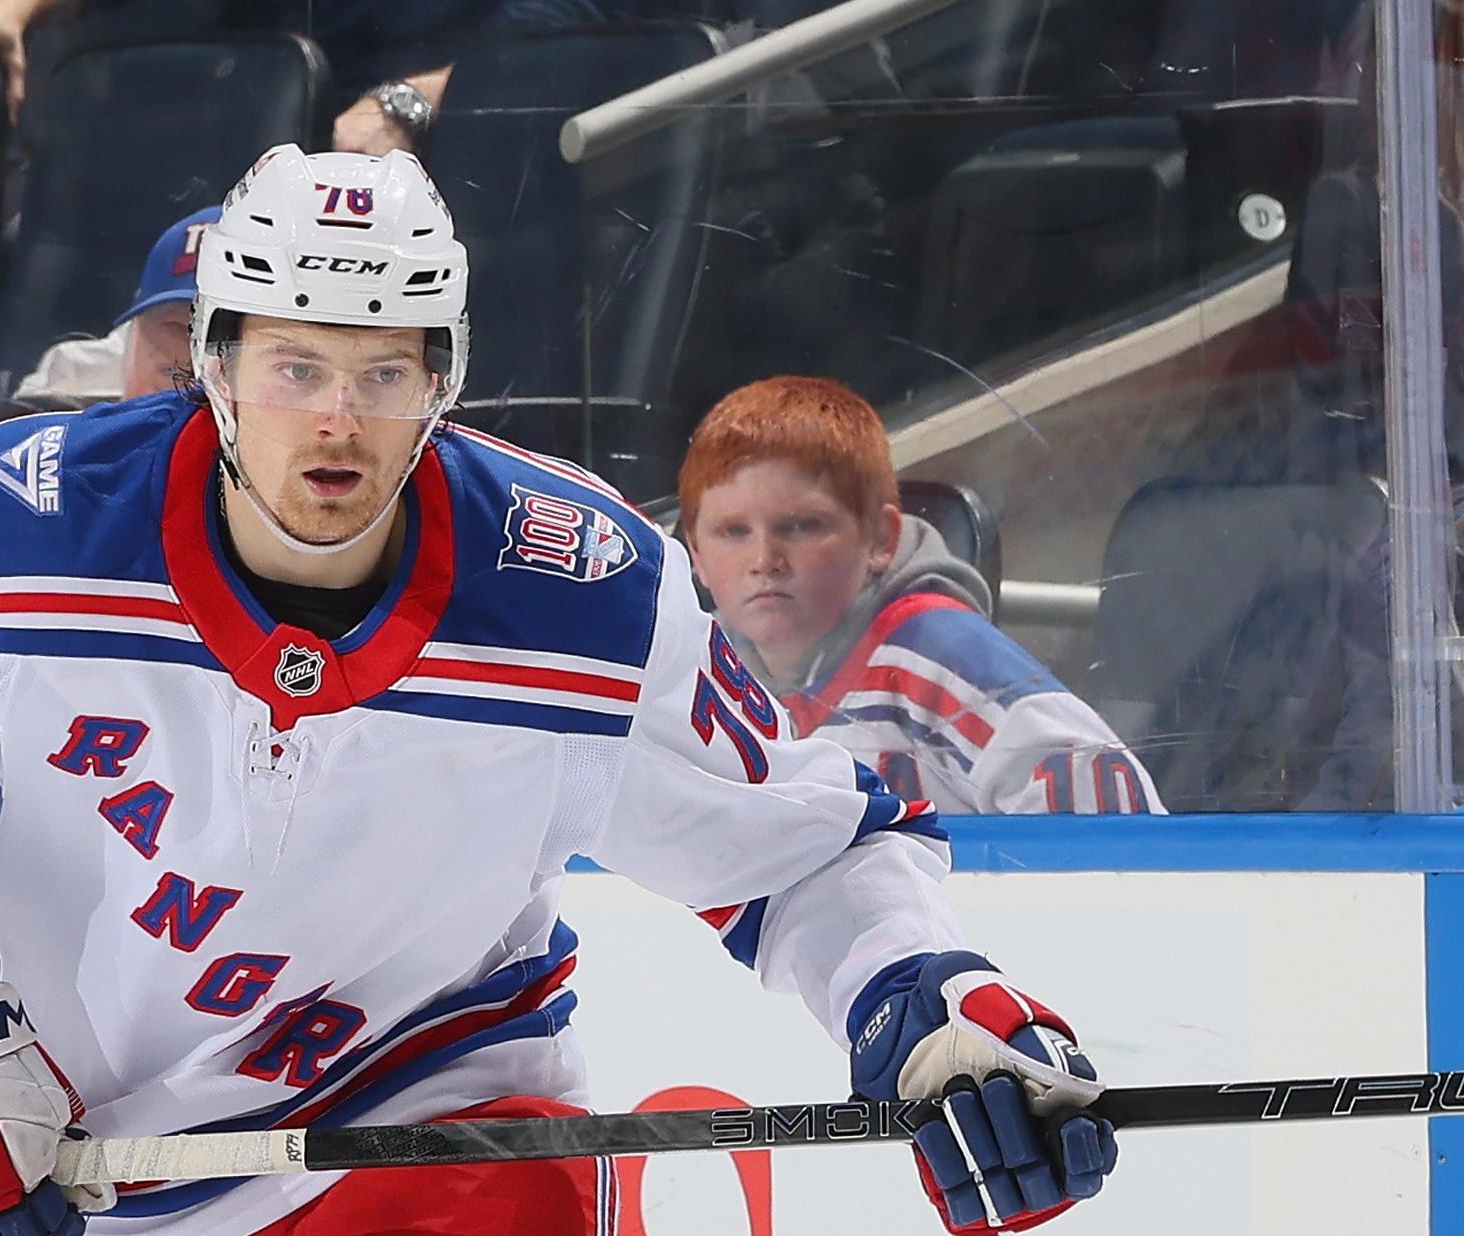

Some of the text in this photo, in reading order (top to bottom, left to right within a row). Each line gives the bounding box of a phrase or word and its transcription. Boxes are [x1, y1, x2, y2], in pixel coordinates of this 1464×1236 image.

[315, 184, 373, 216] 78
[296, 255, 390, 276] CCM
[39, 425, 66, 513] GAME
[516, 495, 584, 573] 100
[284, 662, 315, 683] NHL
[691, 619, 778, 784] 78
[46, 715, 369, 1088] RANGR
[856, 1002, 891, 1055] CCM
[711, 1100, 923, 1147] SMOK
